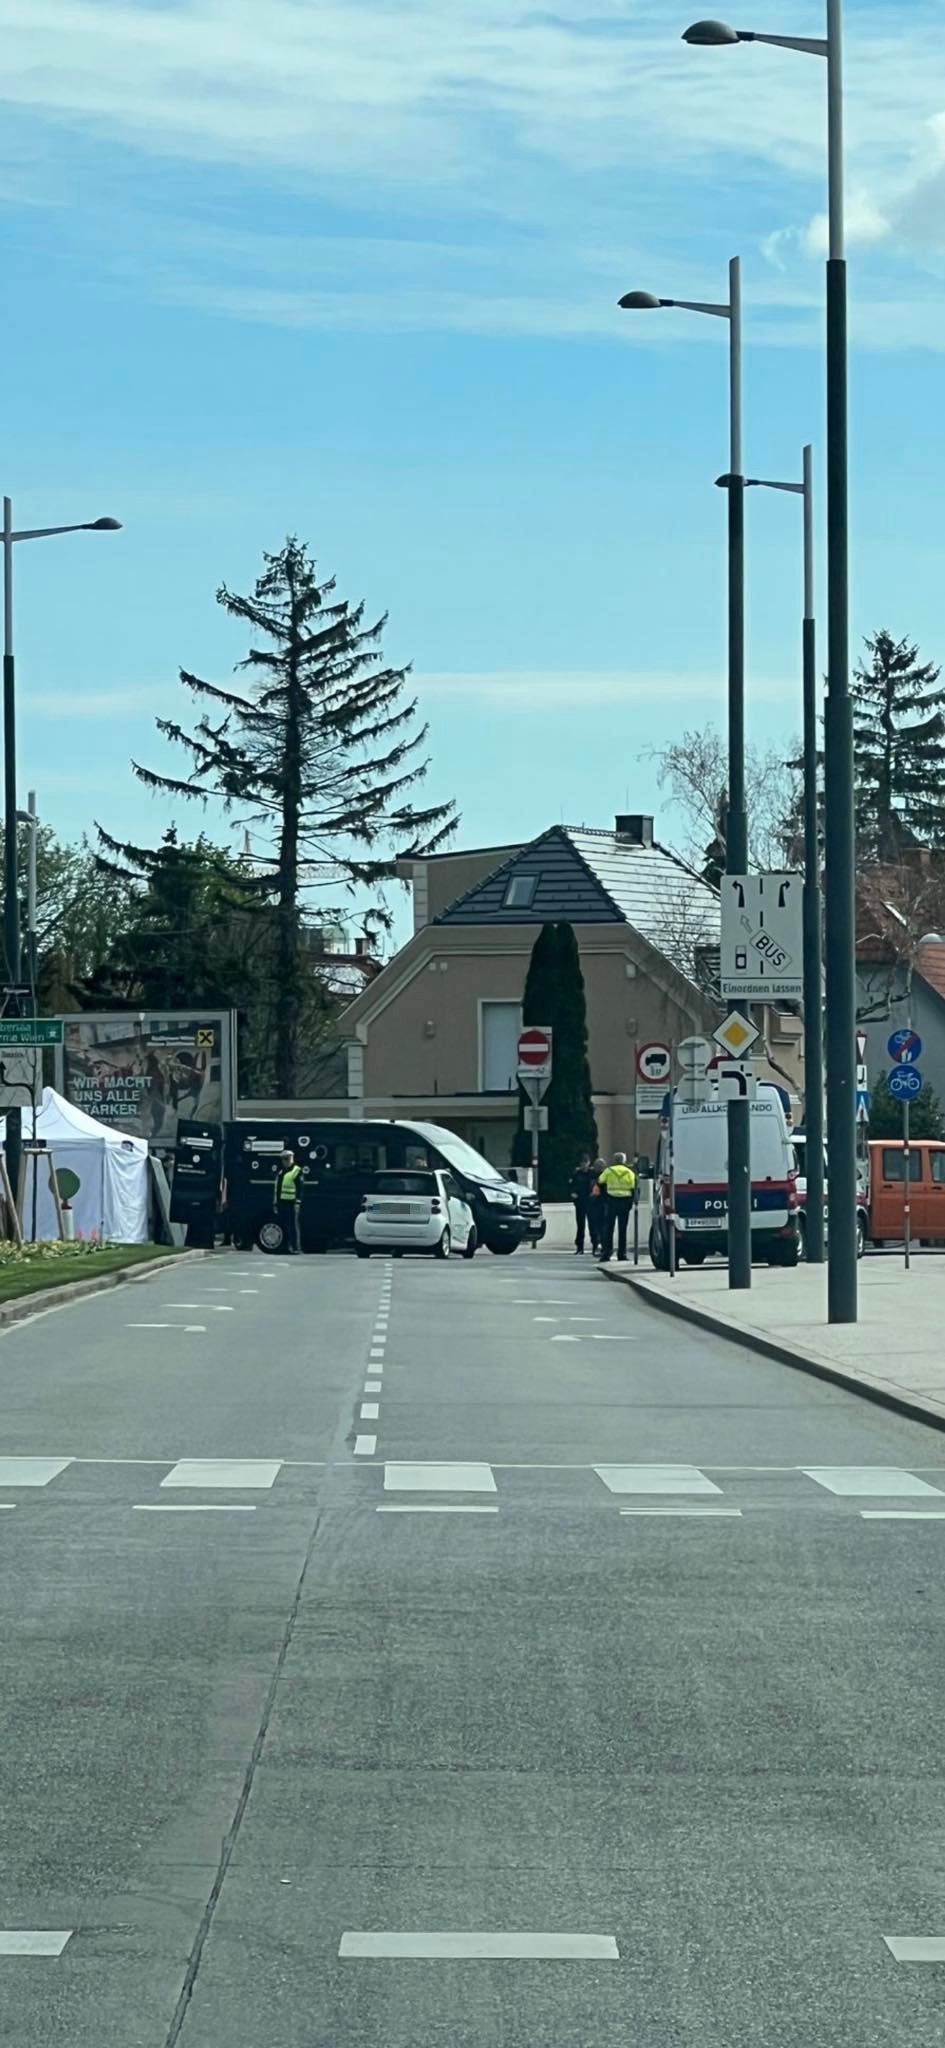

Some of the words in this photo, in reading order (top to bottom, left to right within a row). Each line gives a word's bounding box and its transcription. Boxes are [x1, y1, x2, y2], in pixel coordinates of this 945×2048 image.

[756, 936, 785, 965] BUS
[723, 984, 770, 993] Einordnen
[772, 984, 801, 993] lassen
[73, 1077, 99, 1088] WIR
[104, 1076, 153, 1088] MACHT
[74, 1090, 102, 1101] UNS
[106, 1090, 140, 1101] ALLE
